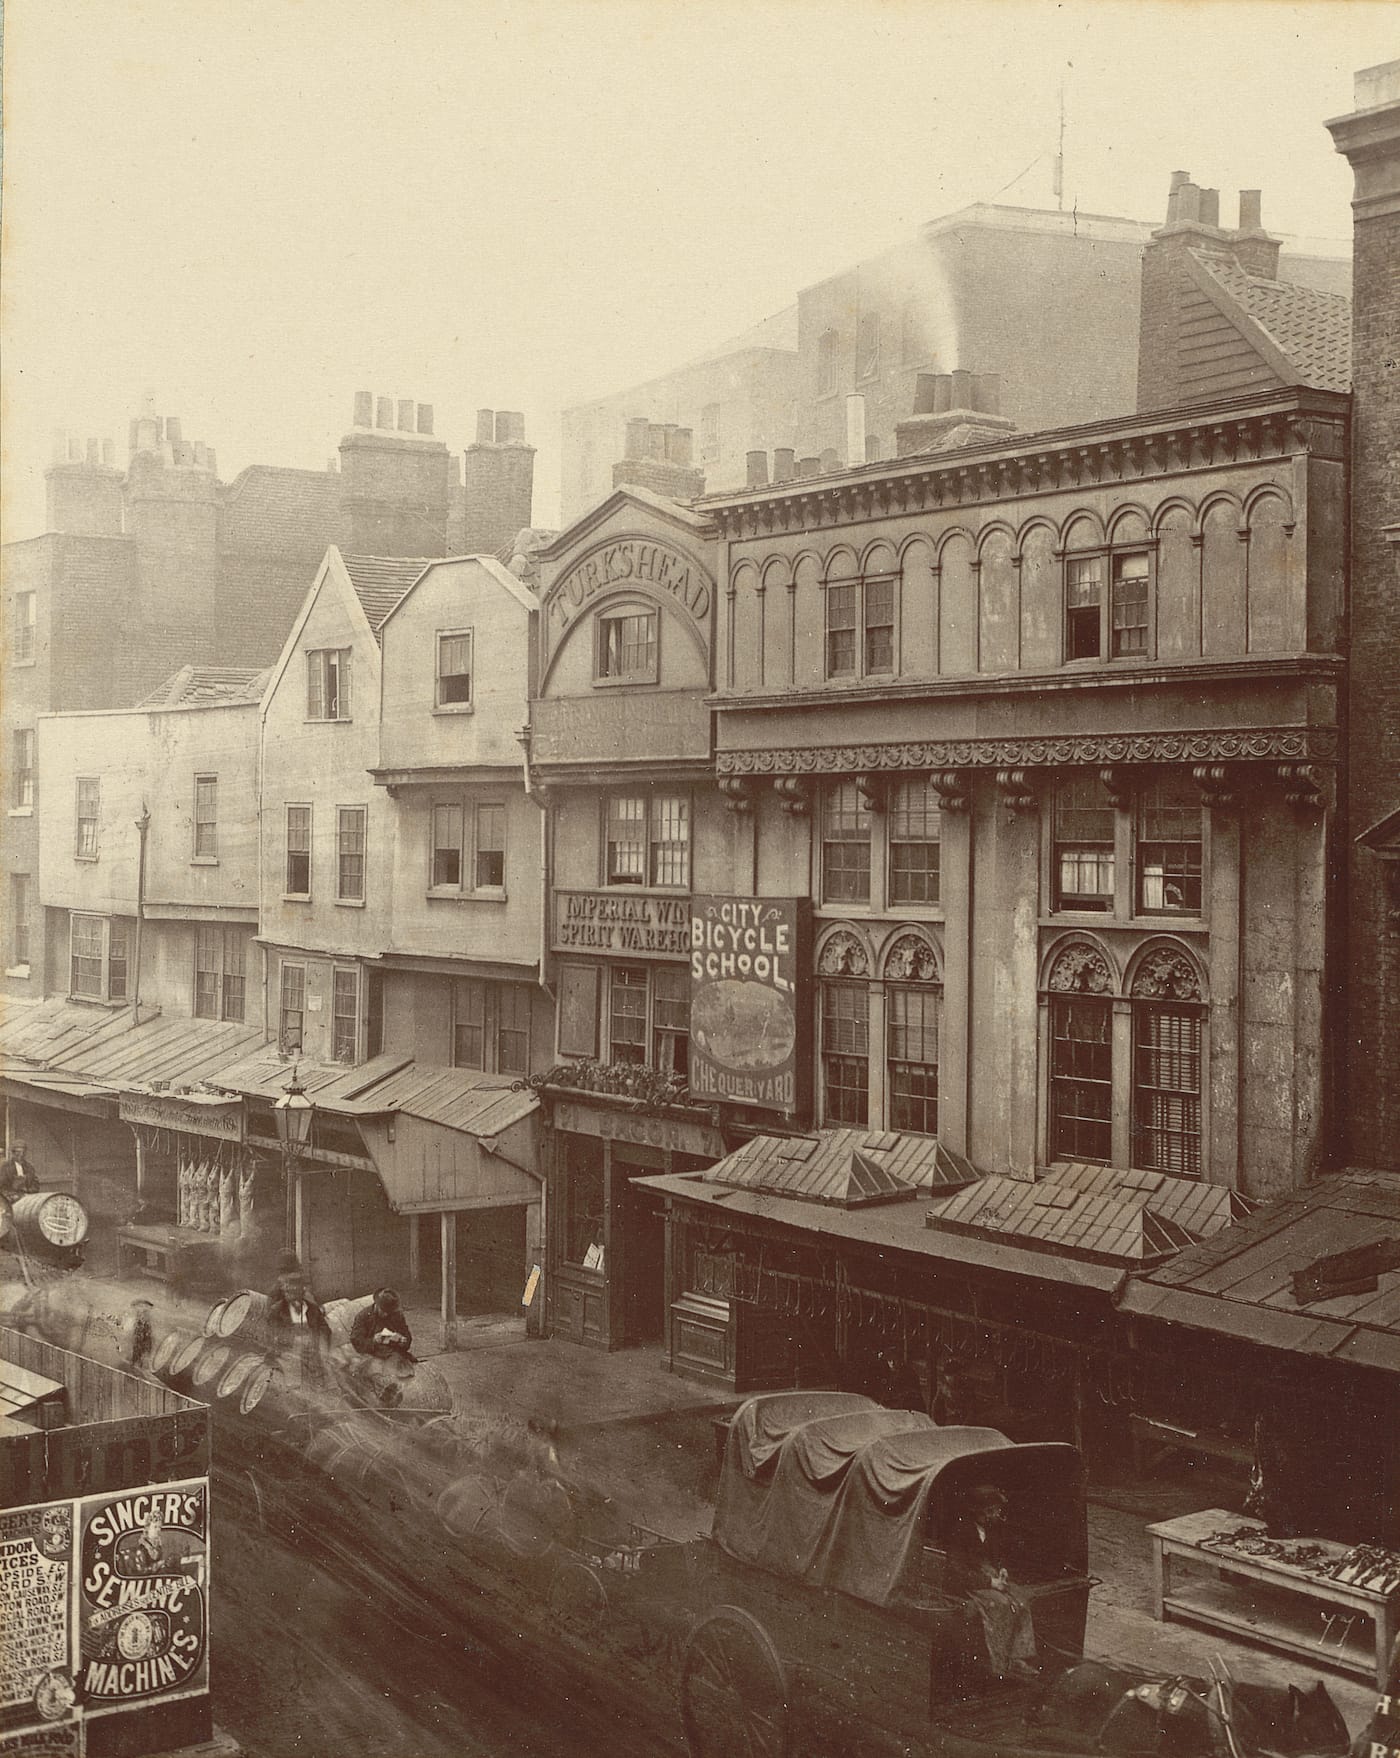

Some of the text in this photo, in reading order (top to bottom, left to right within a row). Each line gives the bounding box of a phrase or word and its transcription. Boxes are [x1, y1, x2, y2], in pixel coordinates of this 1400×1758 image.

[566, 896, 651, 922] IMPERIAL
[721, 903, 762, 928] CITY
[561, 923, 614, 947] SPIRIT
[692, 917, 790, 953] BICYCLE
[757, 1070, 794, 1104] YARD
[90, 1493, 201, 1547] SINGER'S
[0, 1554, 39, 1570] ICES
[85, 1561, 195, 1614] SEWING
[84, 1629, 199, 1696] MACHINES
